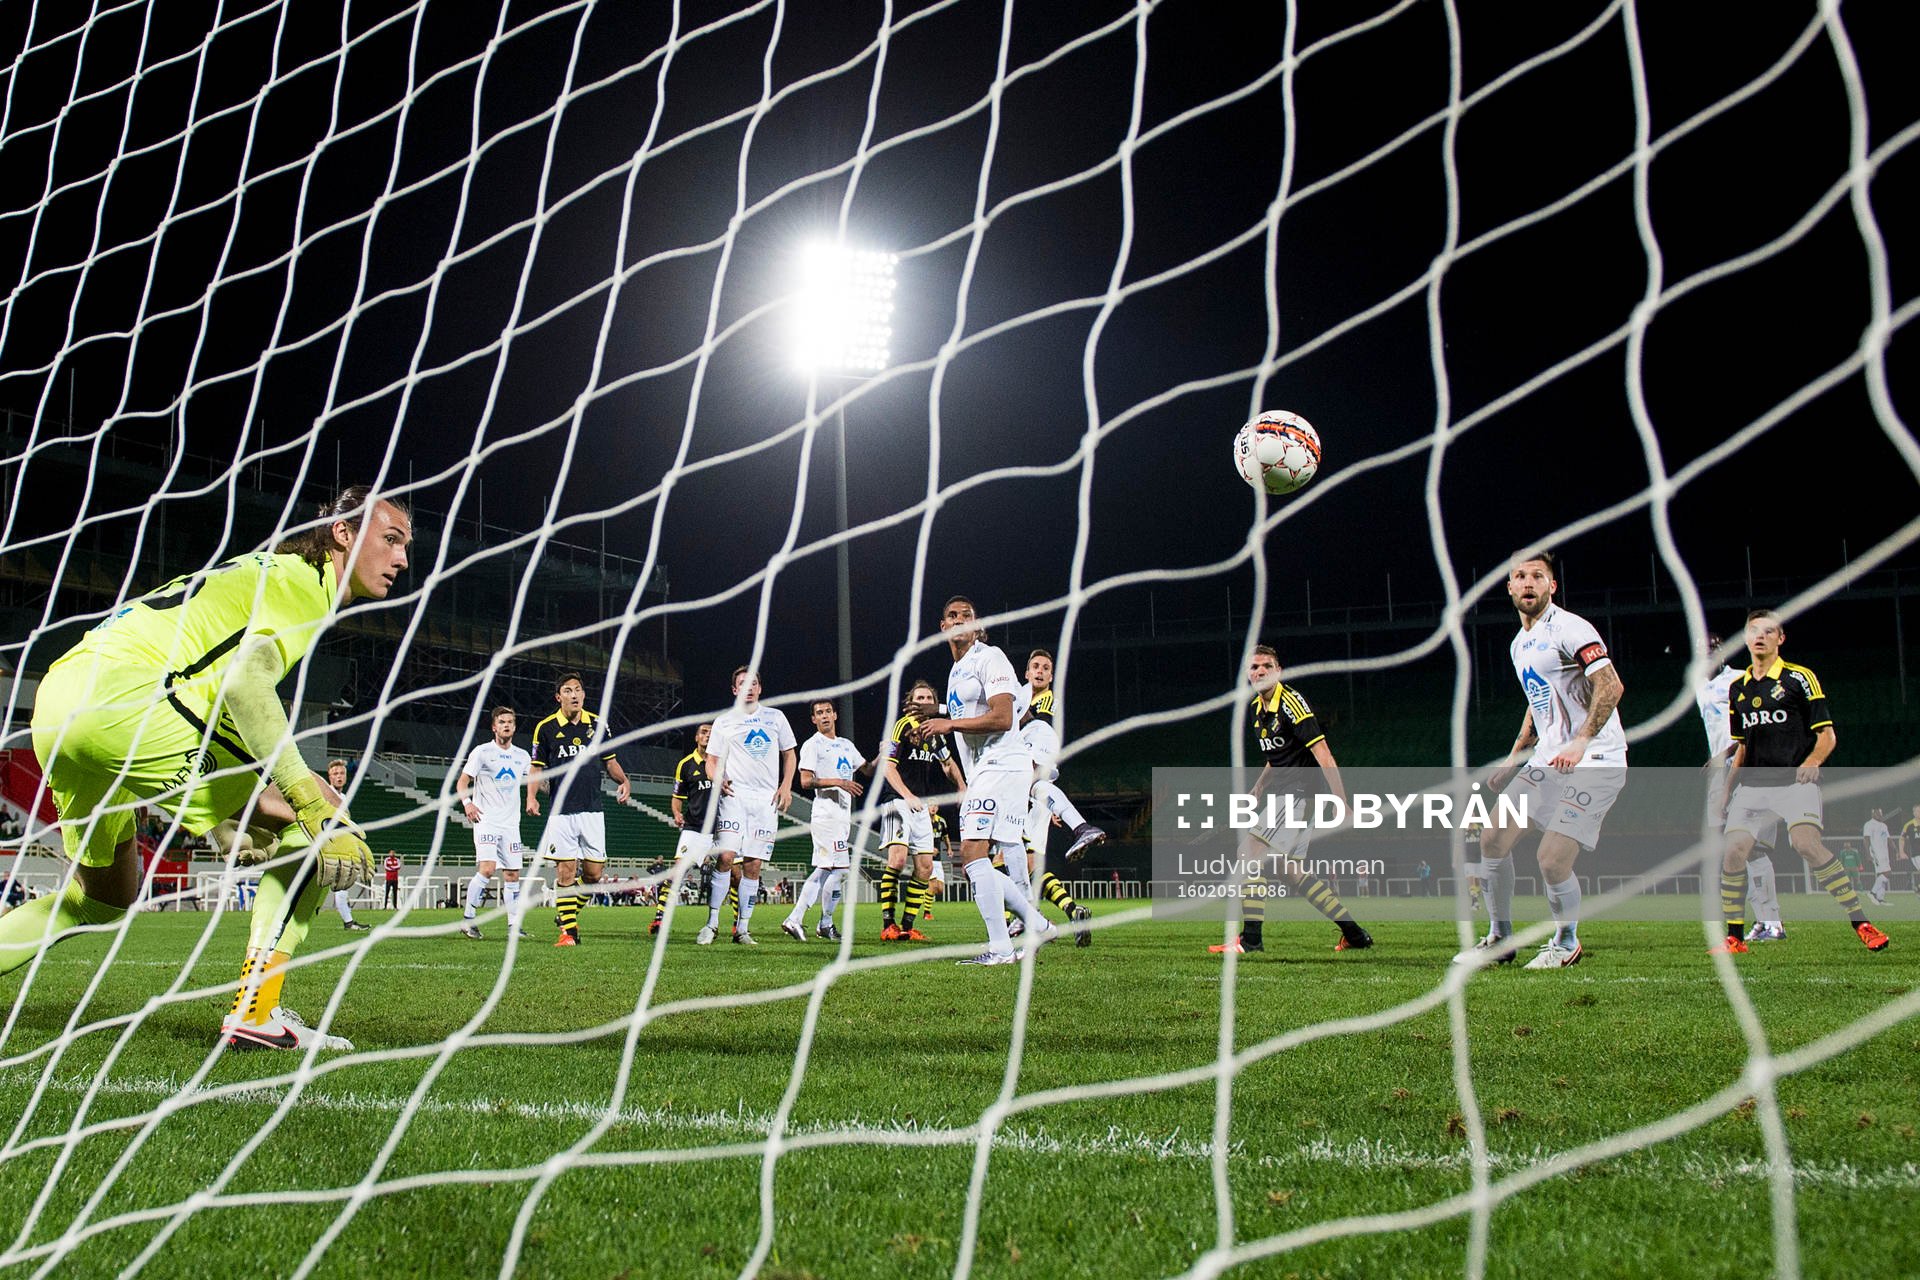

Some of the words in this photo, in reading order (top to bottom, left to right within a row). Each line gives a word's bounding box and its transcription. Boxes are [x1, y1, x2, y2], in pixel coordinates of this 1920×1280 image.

[1585, 647, 1605, 661] MO
[1742, 708, 1788, 729] ABRO
[1258, 736, 1286, 752] BRO
